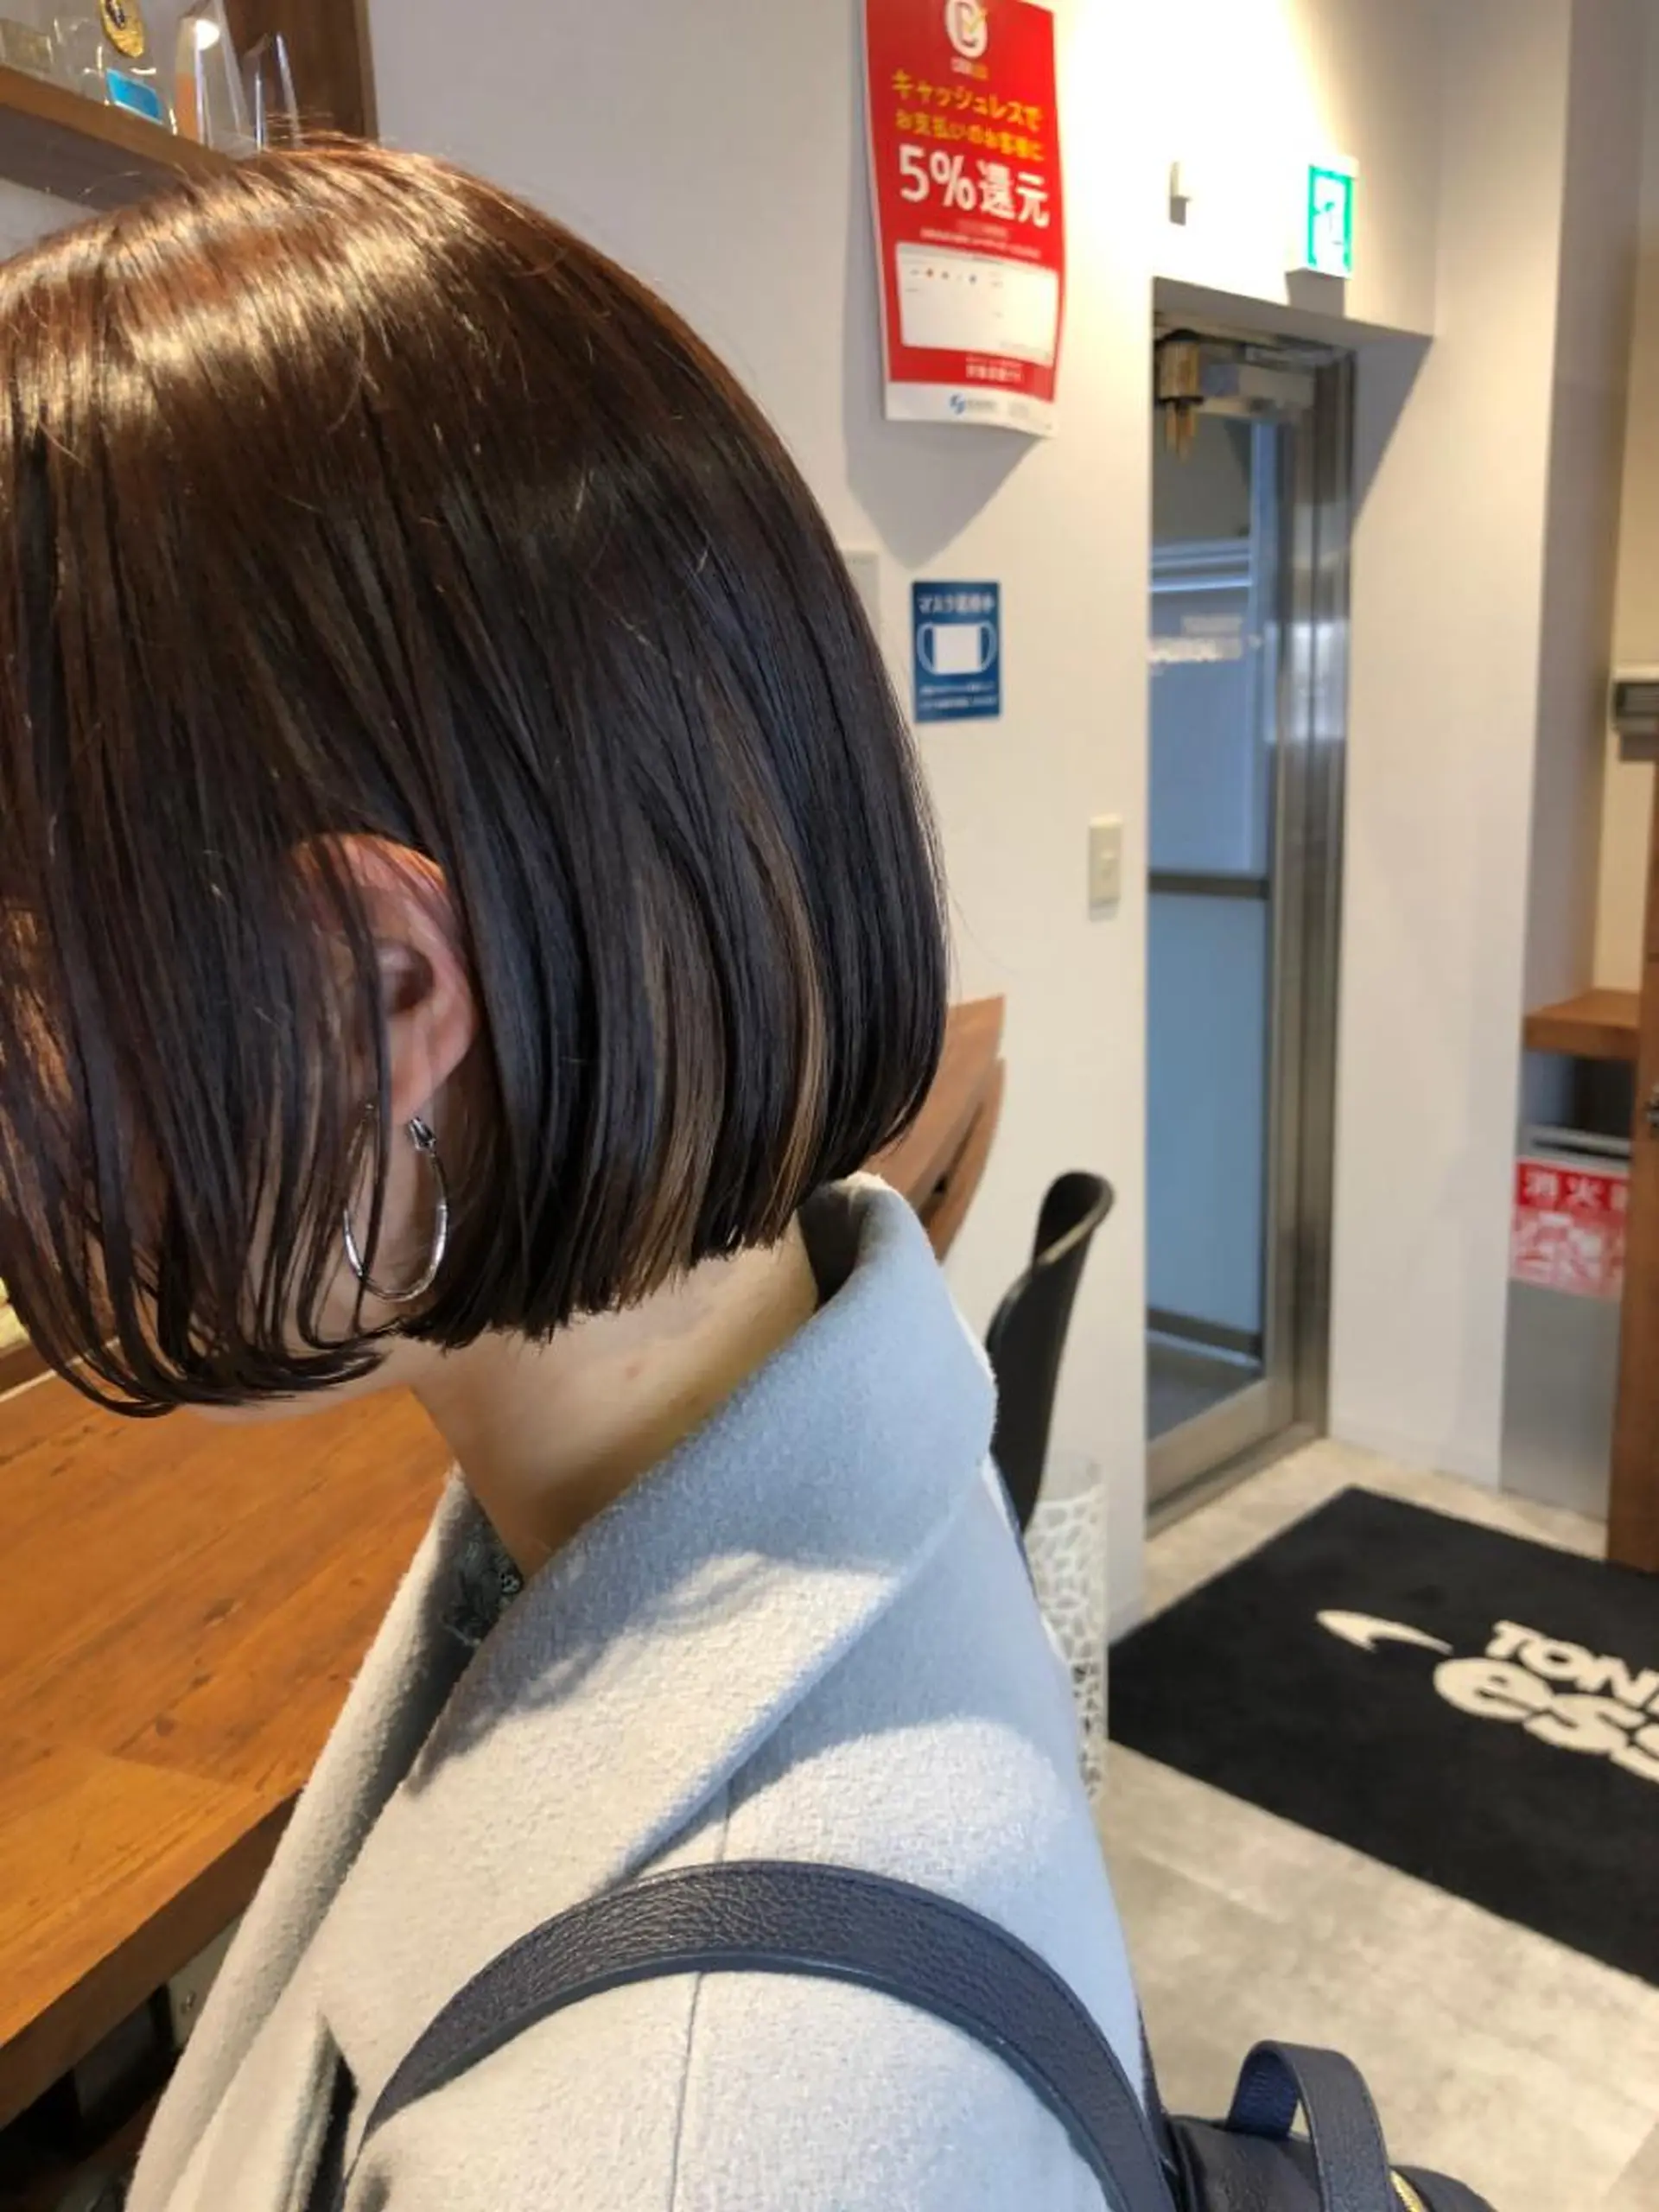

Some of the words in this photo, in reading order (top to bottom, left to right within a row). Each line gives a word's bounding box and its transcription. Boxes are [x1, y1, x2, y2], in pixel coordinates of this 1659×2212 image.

[892, 68, 1043, 132] キャッシュレスで
[899, 143, 1051, 228] 5%還元
